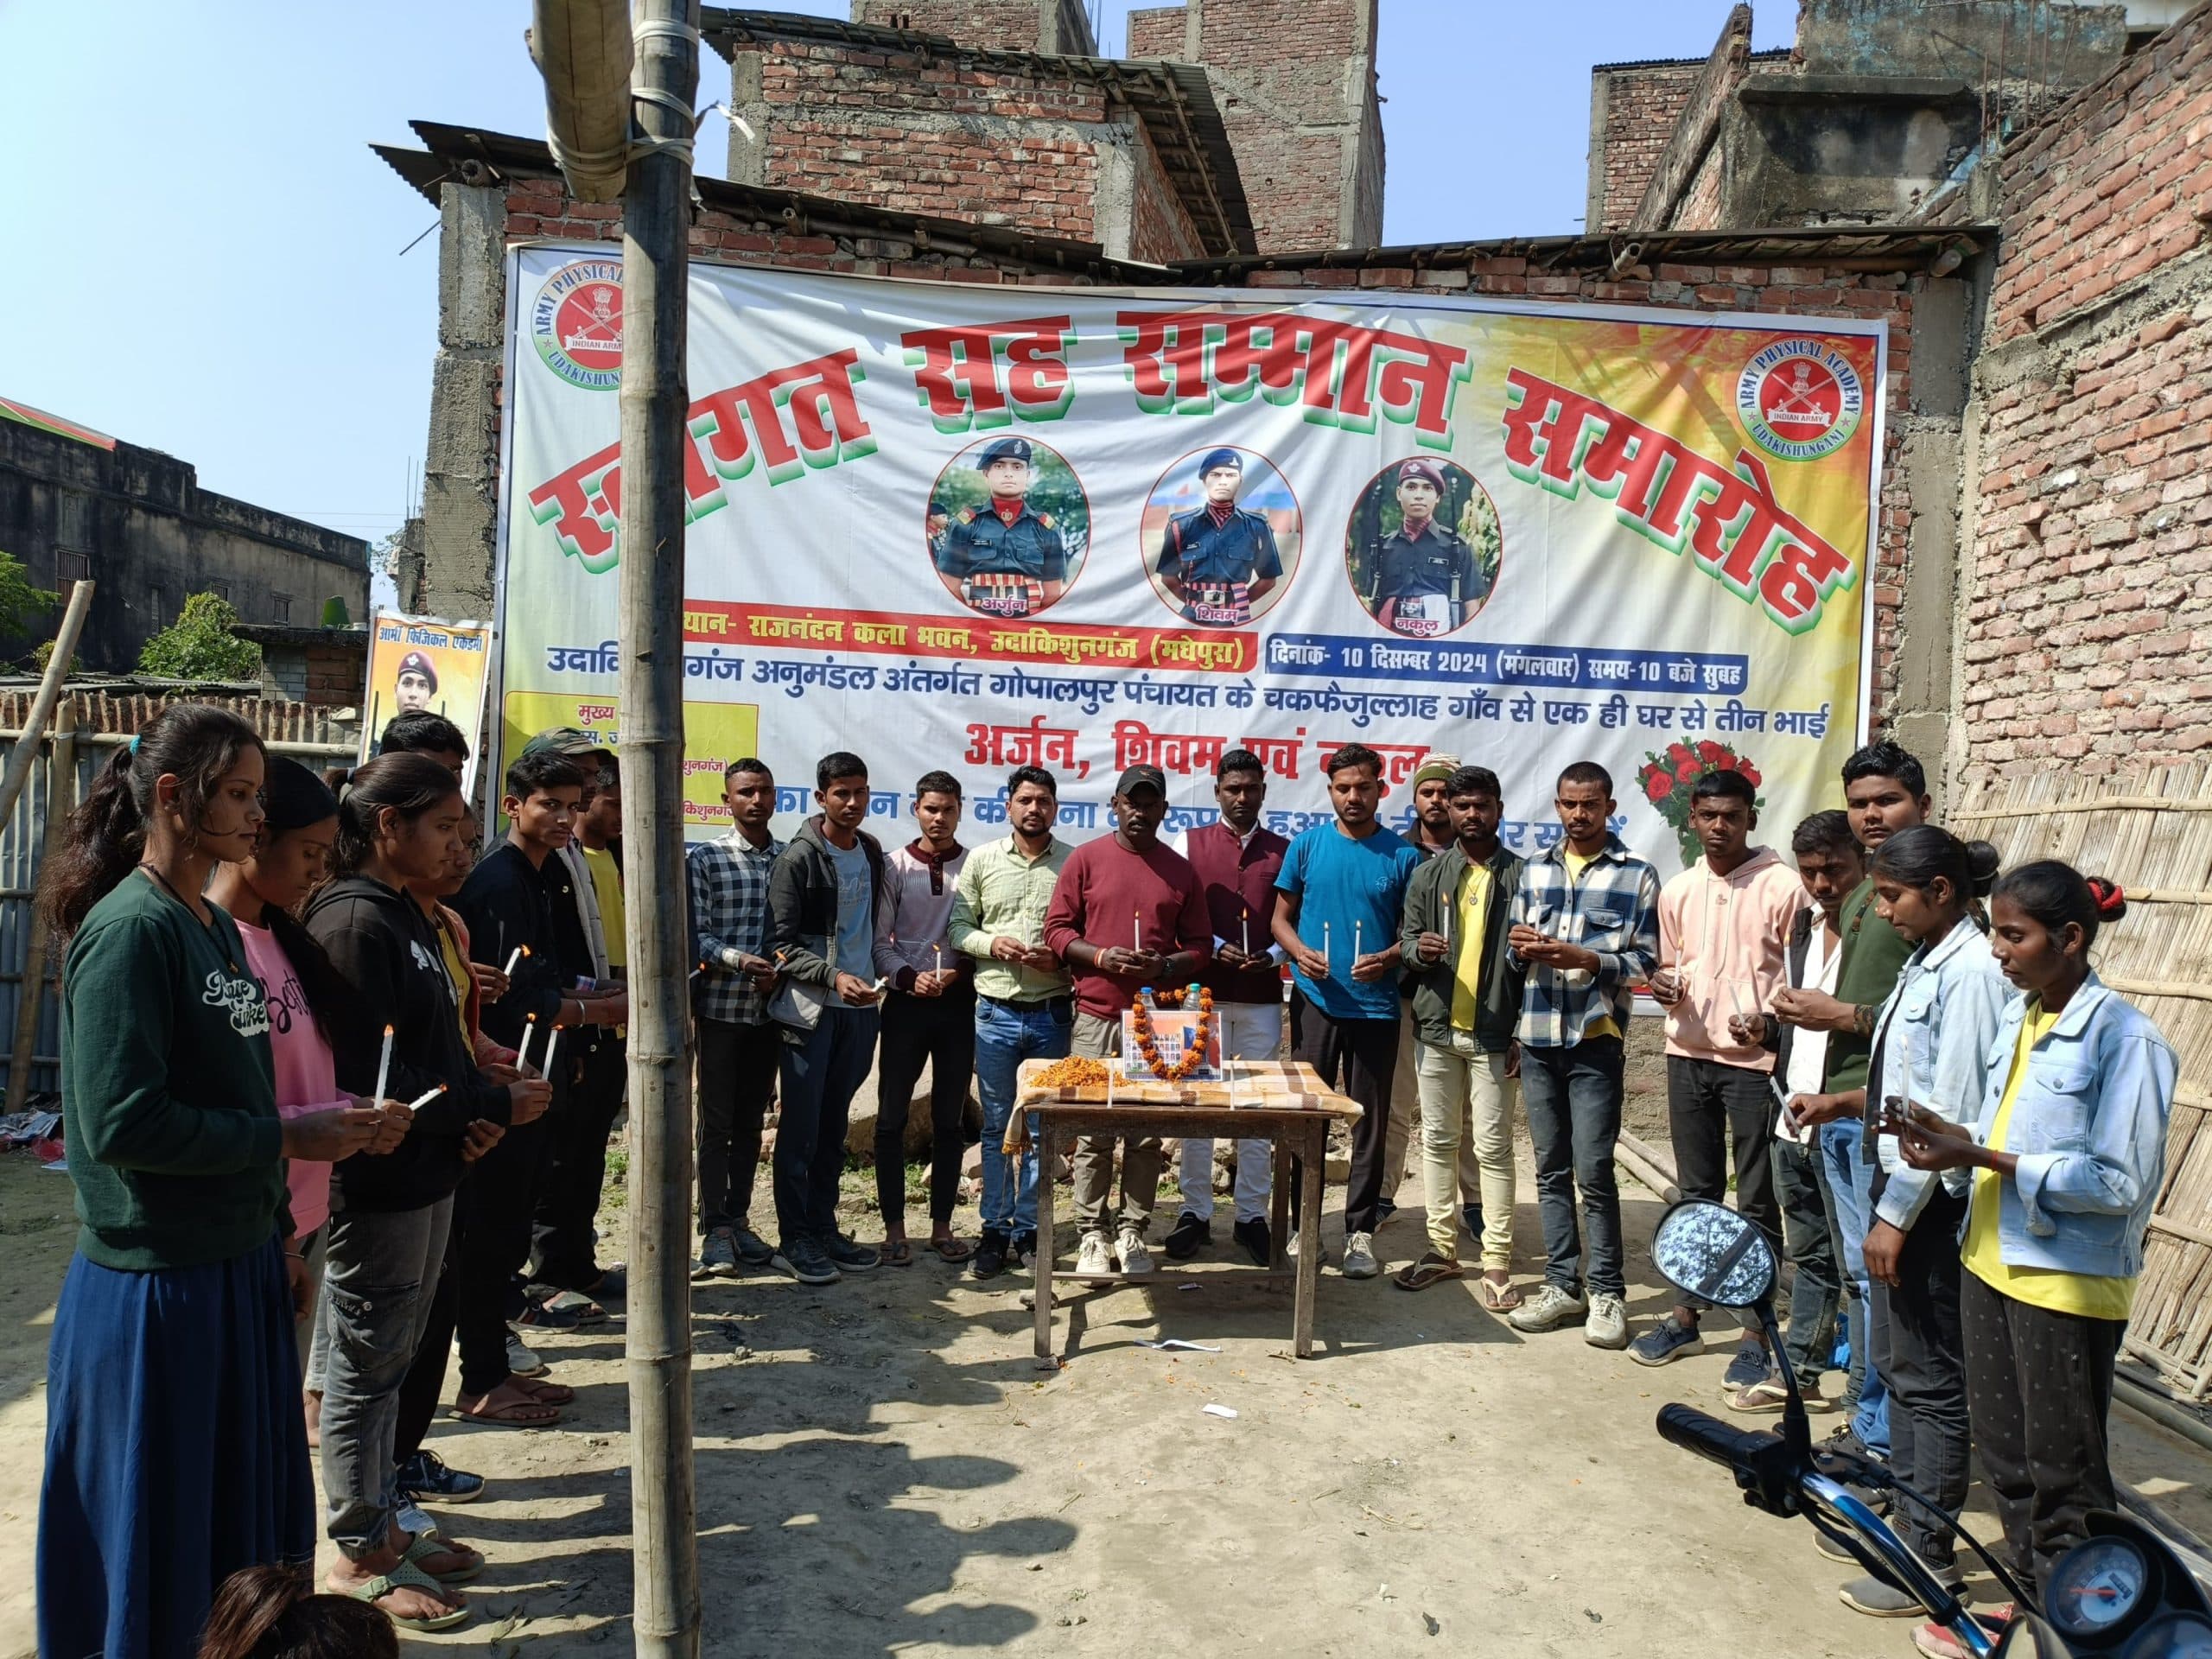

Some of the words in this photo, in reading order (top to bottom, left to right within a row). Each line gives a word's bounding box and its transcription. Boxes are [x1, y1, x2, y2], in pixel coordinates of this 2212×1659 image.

[535, 292, 557, 336] ARMY
[572, 340, 601, 349] INDIAN
[602, 341, 622, 350] ARM
[548, 351, 622, 386] UDAKISHUN
[1740, 366, 1761, 409] ARMY
[1755, 340, 1823, 370] PHYSICAL
[1824, 353, 1860, 416] ACADEMY
[1774, 413, 1800, 422] INDIAN
[1801, 414, 1823, 423] ARMY
[1752, 423, 1845, 456] UDAKISHUNGANJ
[901, 315, 1077, 435] सह
[1116, 311, 1473, 452] सम्मान
[1503, 365, 1857, 637] समारोह
[982, 594, 1027, 616] अर्जुन
[1196, 605, 1239, 622] शिवम
[406, 627, 448, 647] फिजिकल
[747, 613, 844, 642] राजनंदन
[852, 621, 908, 645] कला
[918, 626, 977, 654] भवन,
[990, 627, 1137, 664] उदाकिशुनगंज
[1150, 634, 1243, 670] (मधेपुरा)
[1395, 616, 1439, 635] नकुल
[1341, 647, 1363, 667] 10
[1370, 643, 1432, 671] दिसम्बर
[1438, 652, 1487, 673] 2024
[1496, 649, 1580, 683] (मंगलवार)
[1668, 658, 1697, 683] बजे
[1703, 663, 1742, 690] सुबह
[752, 655, 878, 698] अनुमंडल
[883, 659, 982, 696] अंतर्गत
[990, 666, 1117, 715] गोपालपुर
[1123, 673, 1217, 707] पंचायत
[1225, 677, 1255, 709] के
[1448, 687, 1503, 721] गाँव
[1510, 691, 1535, 722] से
[1543, 701, 1591, 725] एक
[1599, 695, 1629, 728] ही
[1637, 704, 1675, 728] घर
[1681, 699, 1708, 729] से
[1714, 699, 1767, 733] तीन
[1773, 702, 1829, 738] भाई
[579, 704, 615, 726] मुख्य
